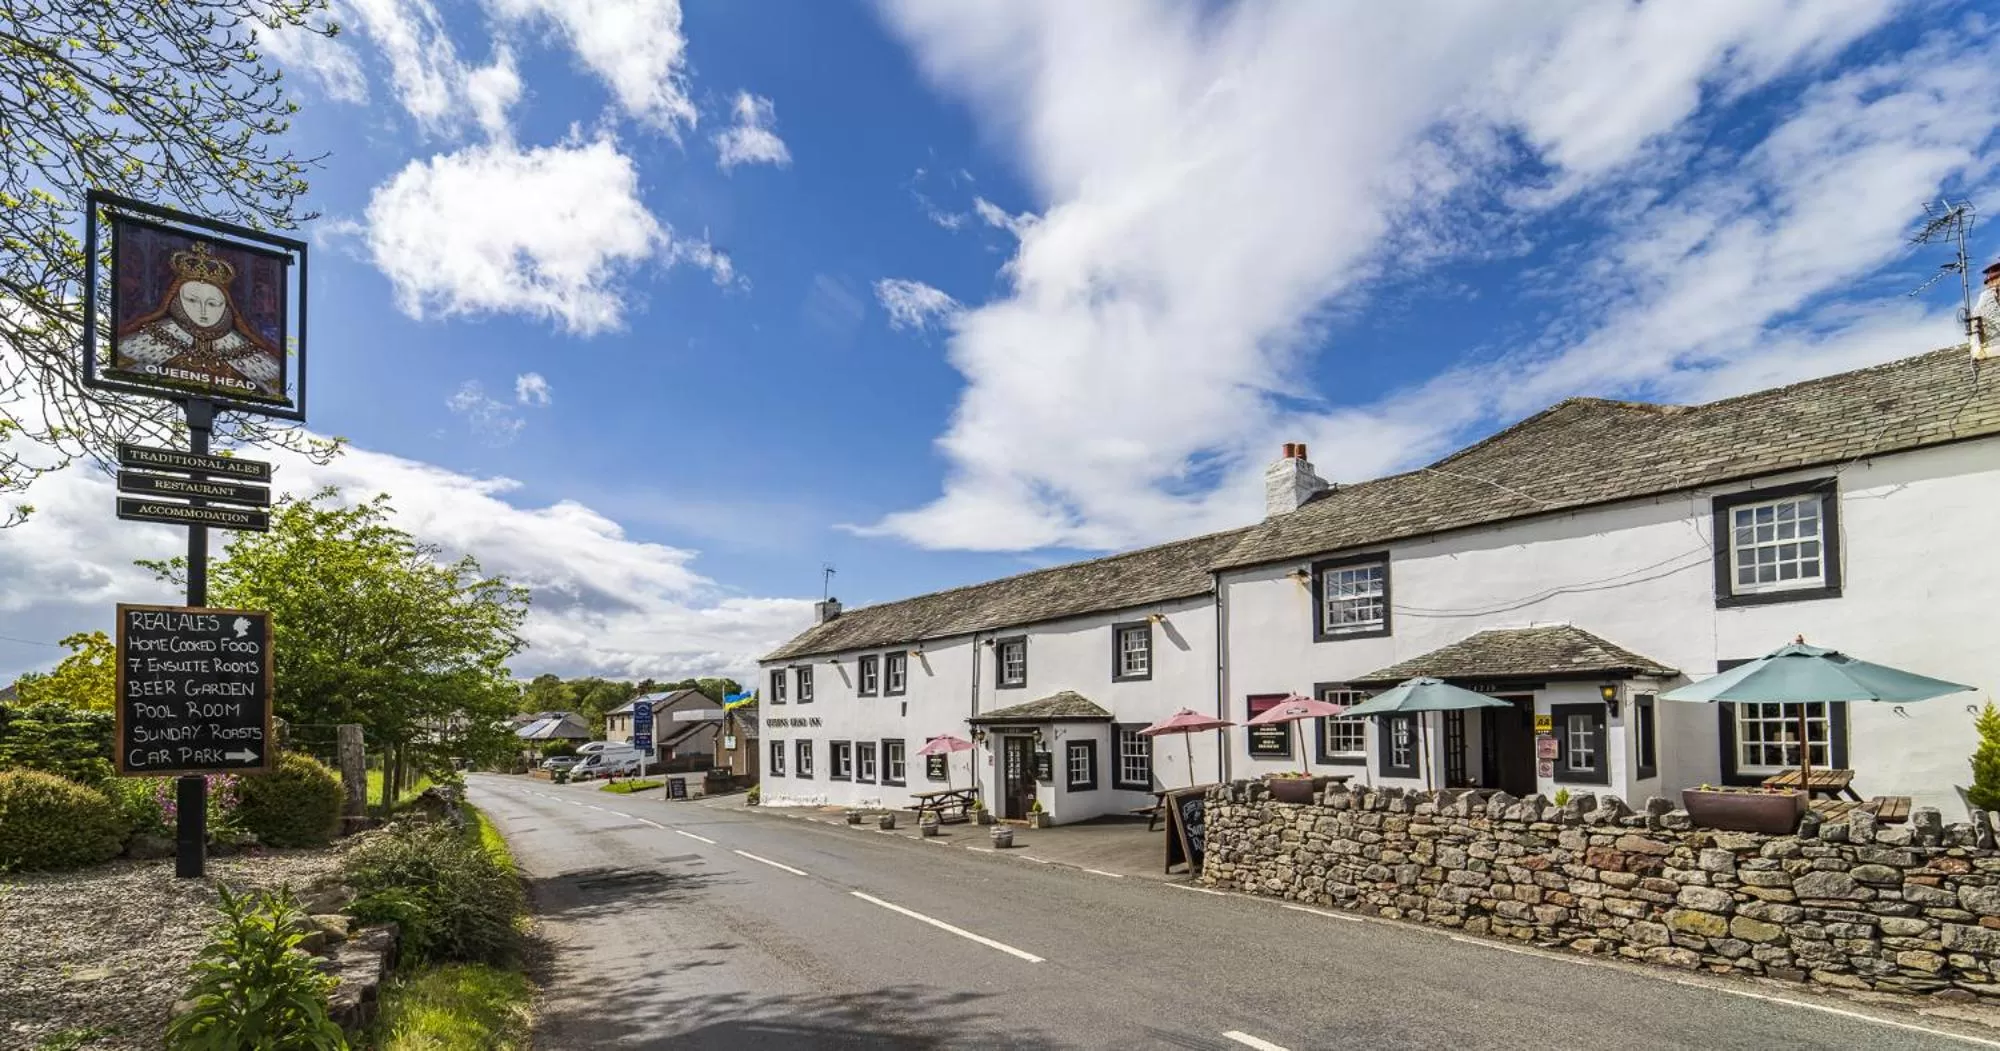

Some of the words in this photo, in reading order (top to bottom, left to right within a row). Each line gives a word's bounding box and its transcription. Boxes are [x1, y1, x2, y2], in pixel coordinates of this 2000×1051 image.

[145, 364, 210, 383] QUEENS
[215, 374, 257, 391] HEAD
[130, 450, 224, 470] TRADITIONAL
[228, 462, 260, 474] ALES
[155, 479, 236, 496] RESTAURANT
[138, 504, 249, 523] ACCOMMODATION
[128, 636, 168, 651] HOME
[170, 635, 216, 653] COOKED
[220, 637, 259, 654] FOOD
[128, 658, 142, 673] 7
[147, 658, 209, 673] ENSUITE
[128, 680, 176, 697] BEER
[184, 679, 254, 697] GARDEN
[133, 702, 177, 719] POOL
[185, 701, 240, 718] ROOM
[1537, 718, 1550, 726] AA
[133, 725, 201, 743] SUNDAY
[209, 723, 262, 740] ROASTS
[129, 749, 172, 767] CAR
[178, 747, 223, 764] PARK
